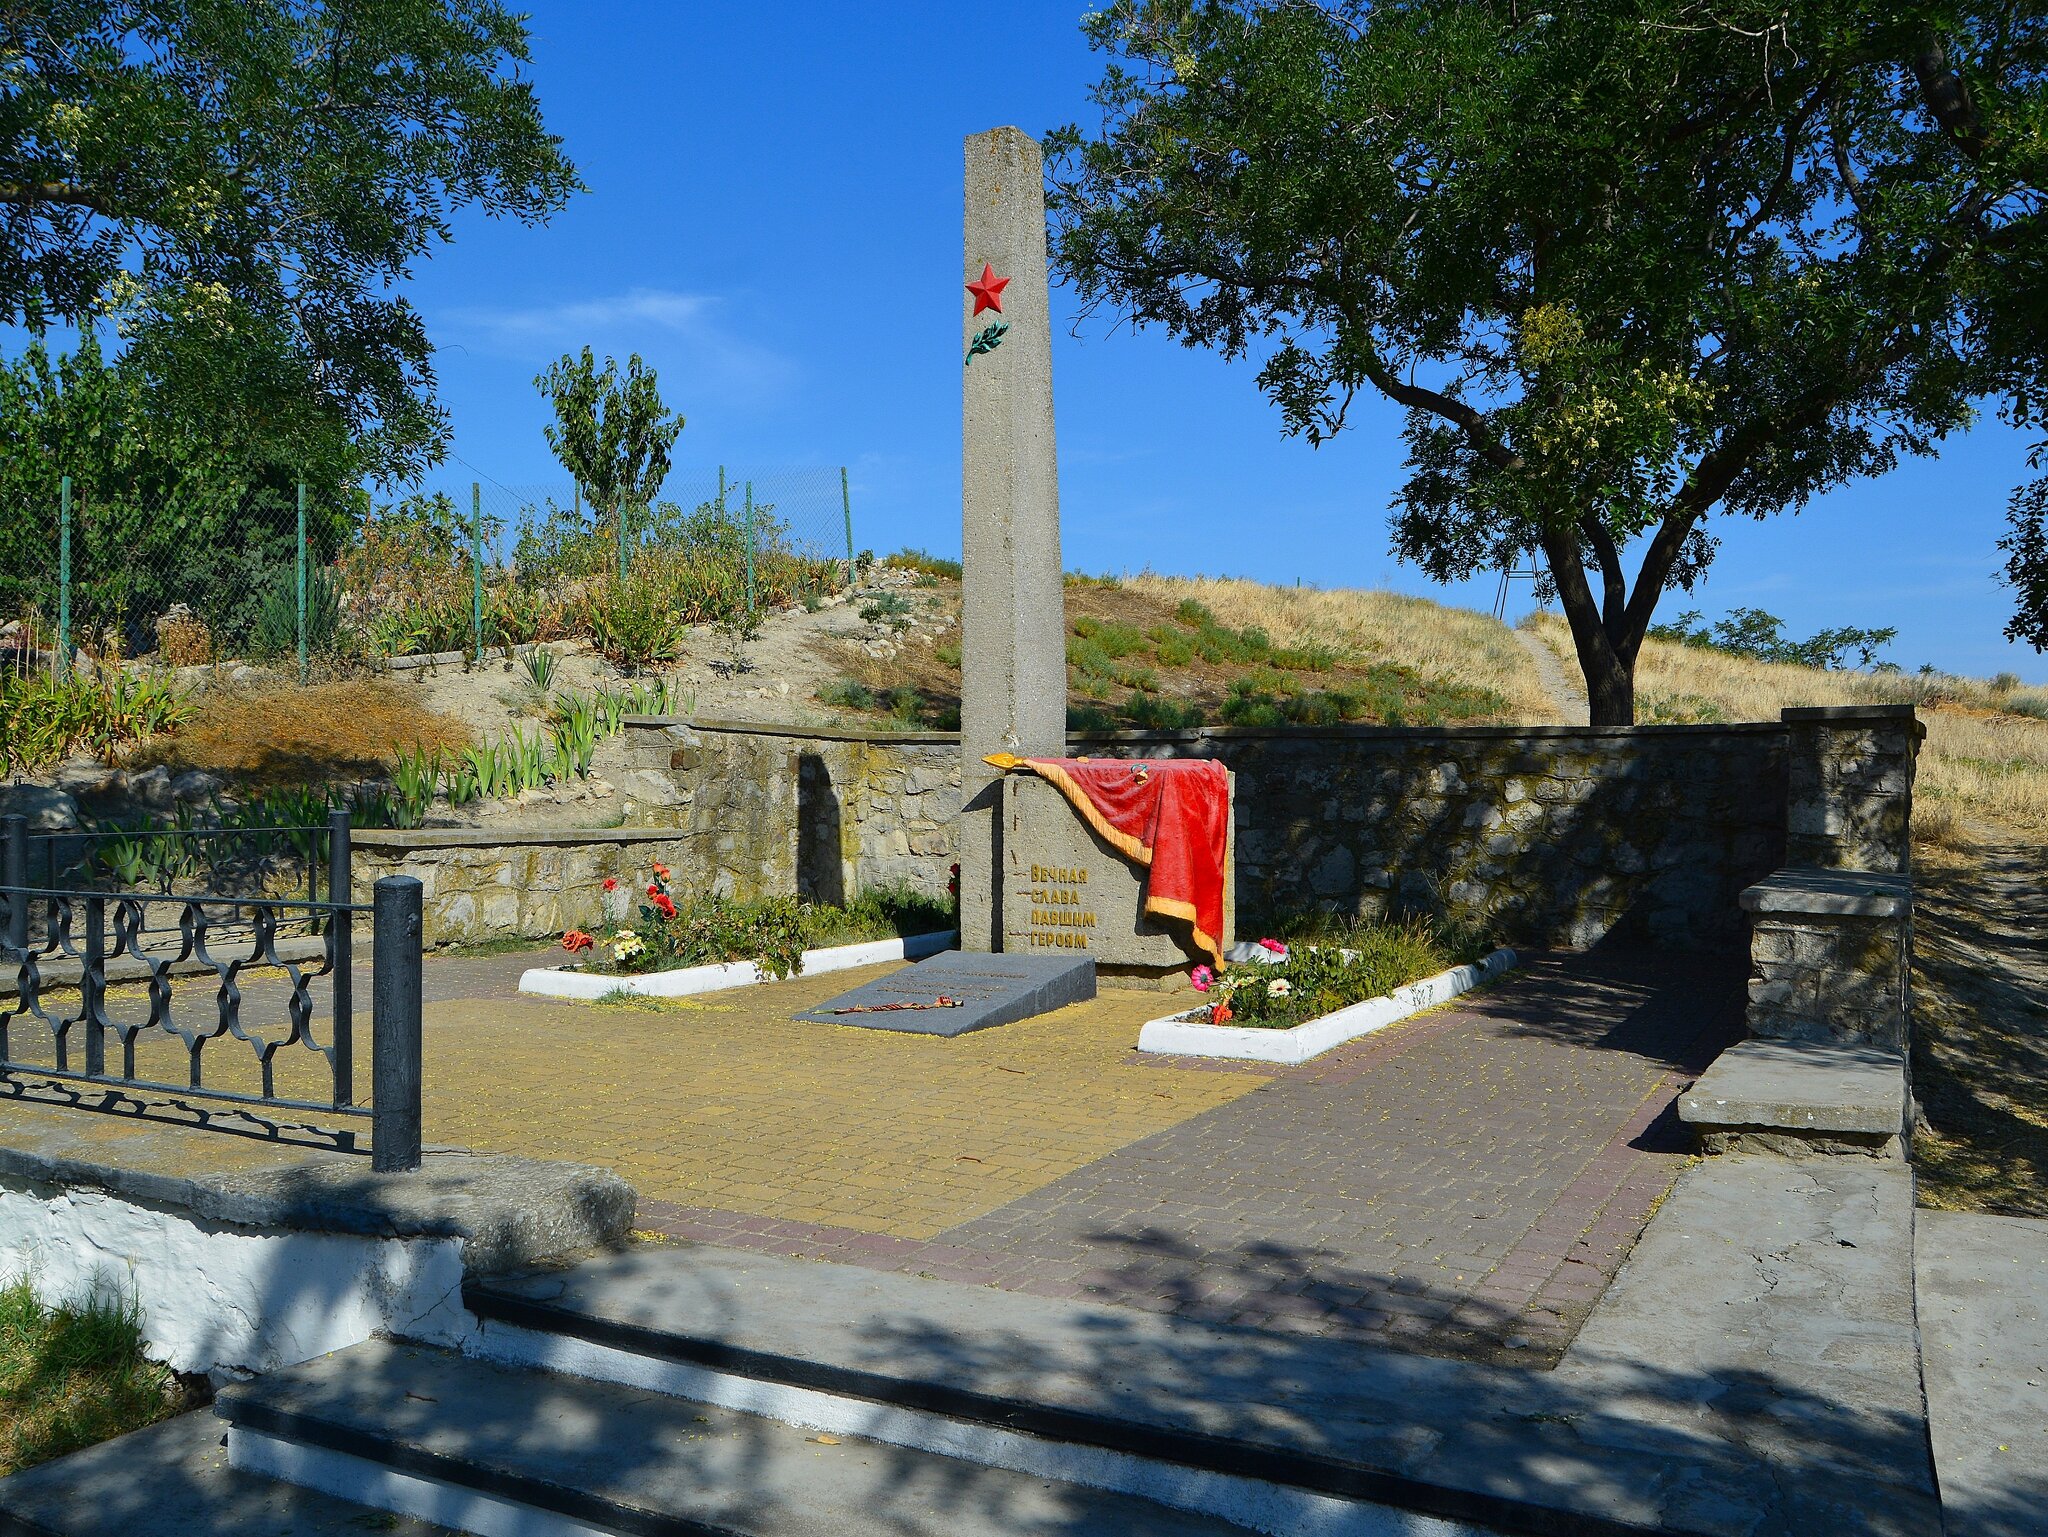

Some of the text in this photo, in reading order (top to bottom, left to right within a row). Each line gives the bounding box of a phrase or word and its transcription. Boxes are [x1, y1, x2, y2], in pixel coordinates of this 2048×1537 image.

[1031, 864, 1088, 883] ВЕЧНАЯ
[1031, 889, 1079, 905] СЛАВА
[1031, 910, 1097, 928] ПАВШИМ
[1030, 931, 1088, 949] ГЕРОЯМ
